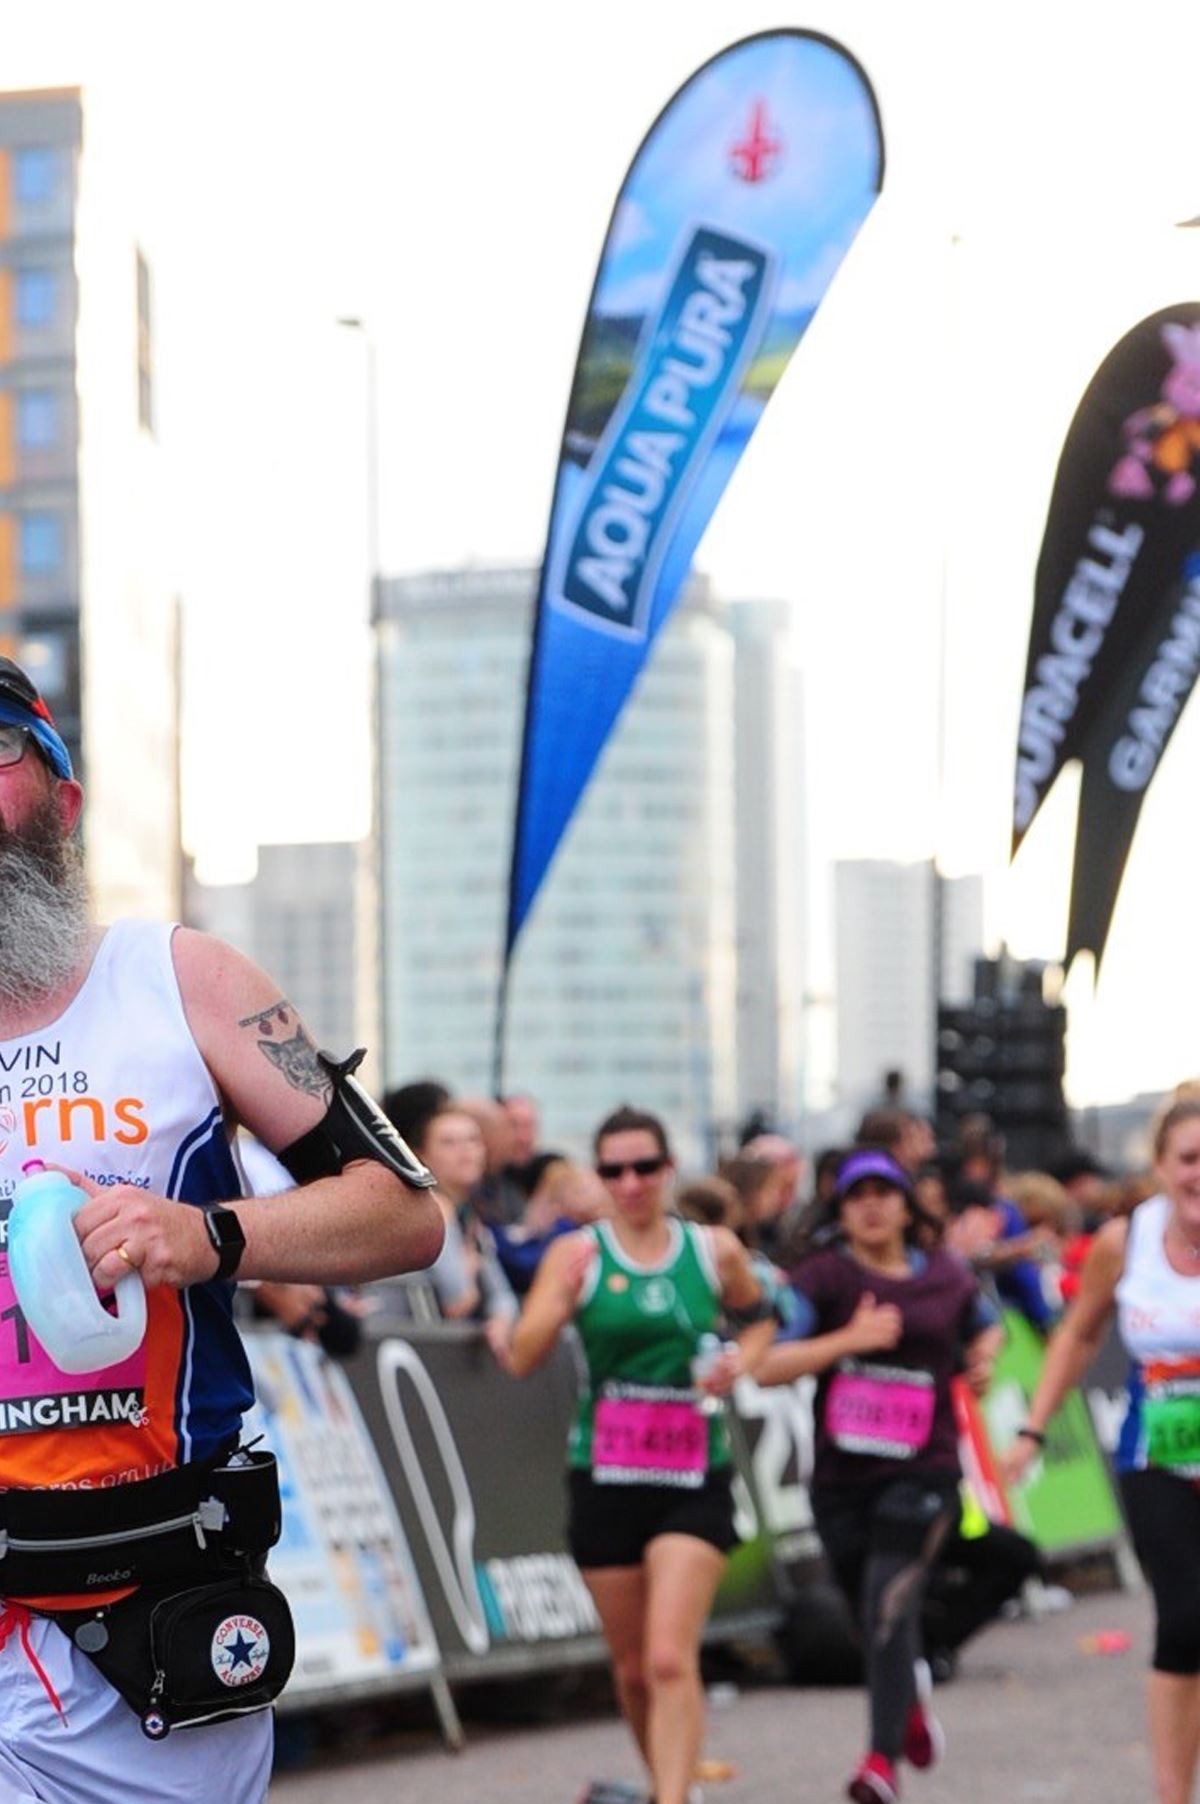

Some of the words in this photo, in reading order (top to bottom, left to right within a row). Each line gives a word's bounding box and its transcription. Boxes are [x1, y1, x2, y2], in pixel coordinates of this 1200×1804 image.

[574, 428, 689, 611] AQUA
[643, 251, 757, 427] PURA
[20, 1071, 89, 1099] 2018
[216, 1618, 265, 1645] CONVERSE
